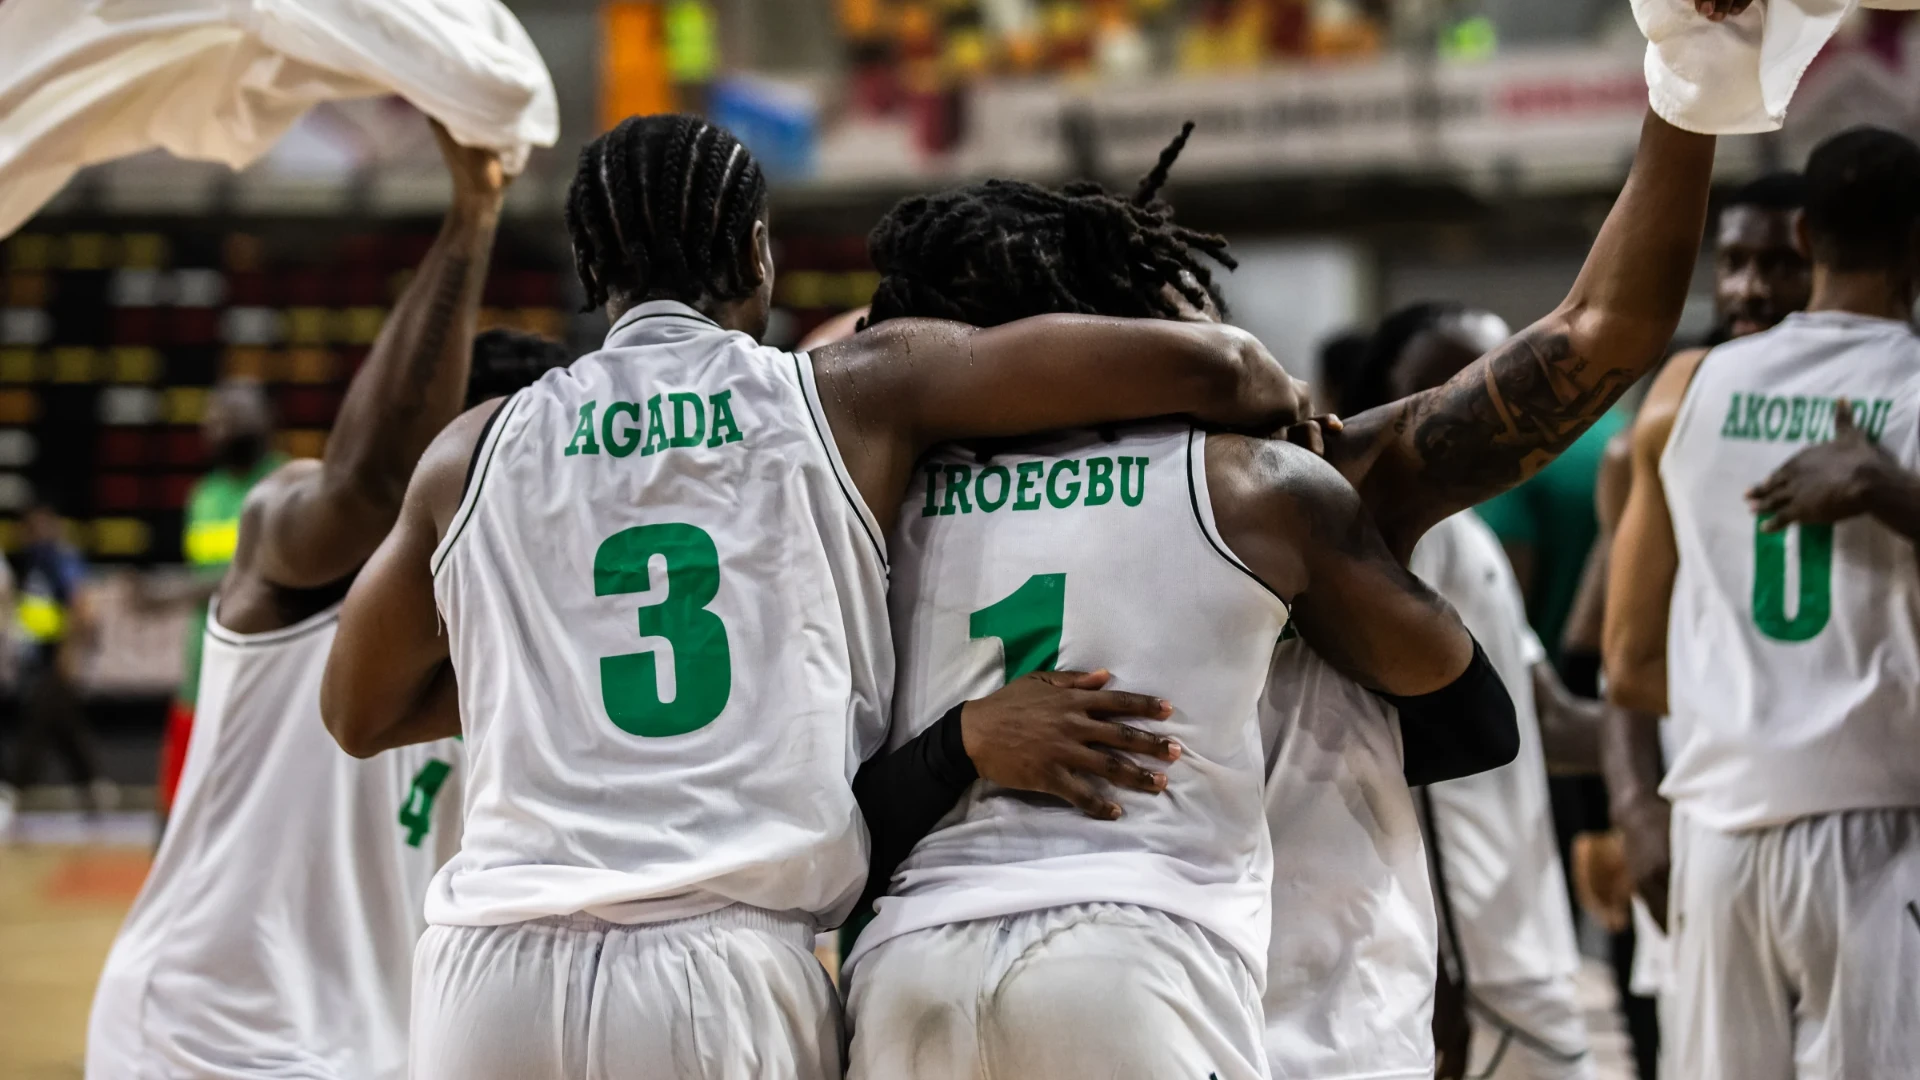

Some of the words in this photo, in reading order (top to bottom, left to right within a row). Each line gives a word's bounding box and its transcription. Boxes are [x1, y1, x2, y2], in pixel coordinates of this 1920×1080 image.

[564, 389, 743, 458] AGADA
[922, 456, 1149, 517] IROEGBU
[1753, 511, 1834, 642] 0
[593, 522, 732, 738] 3
[399, 758, 451, 848] 4
